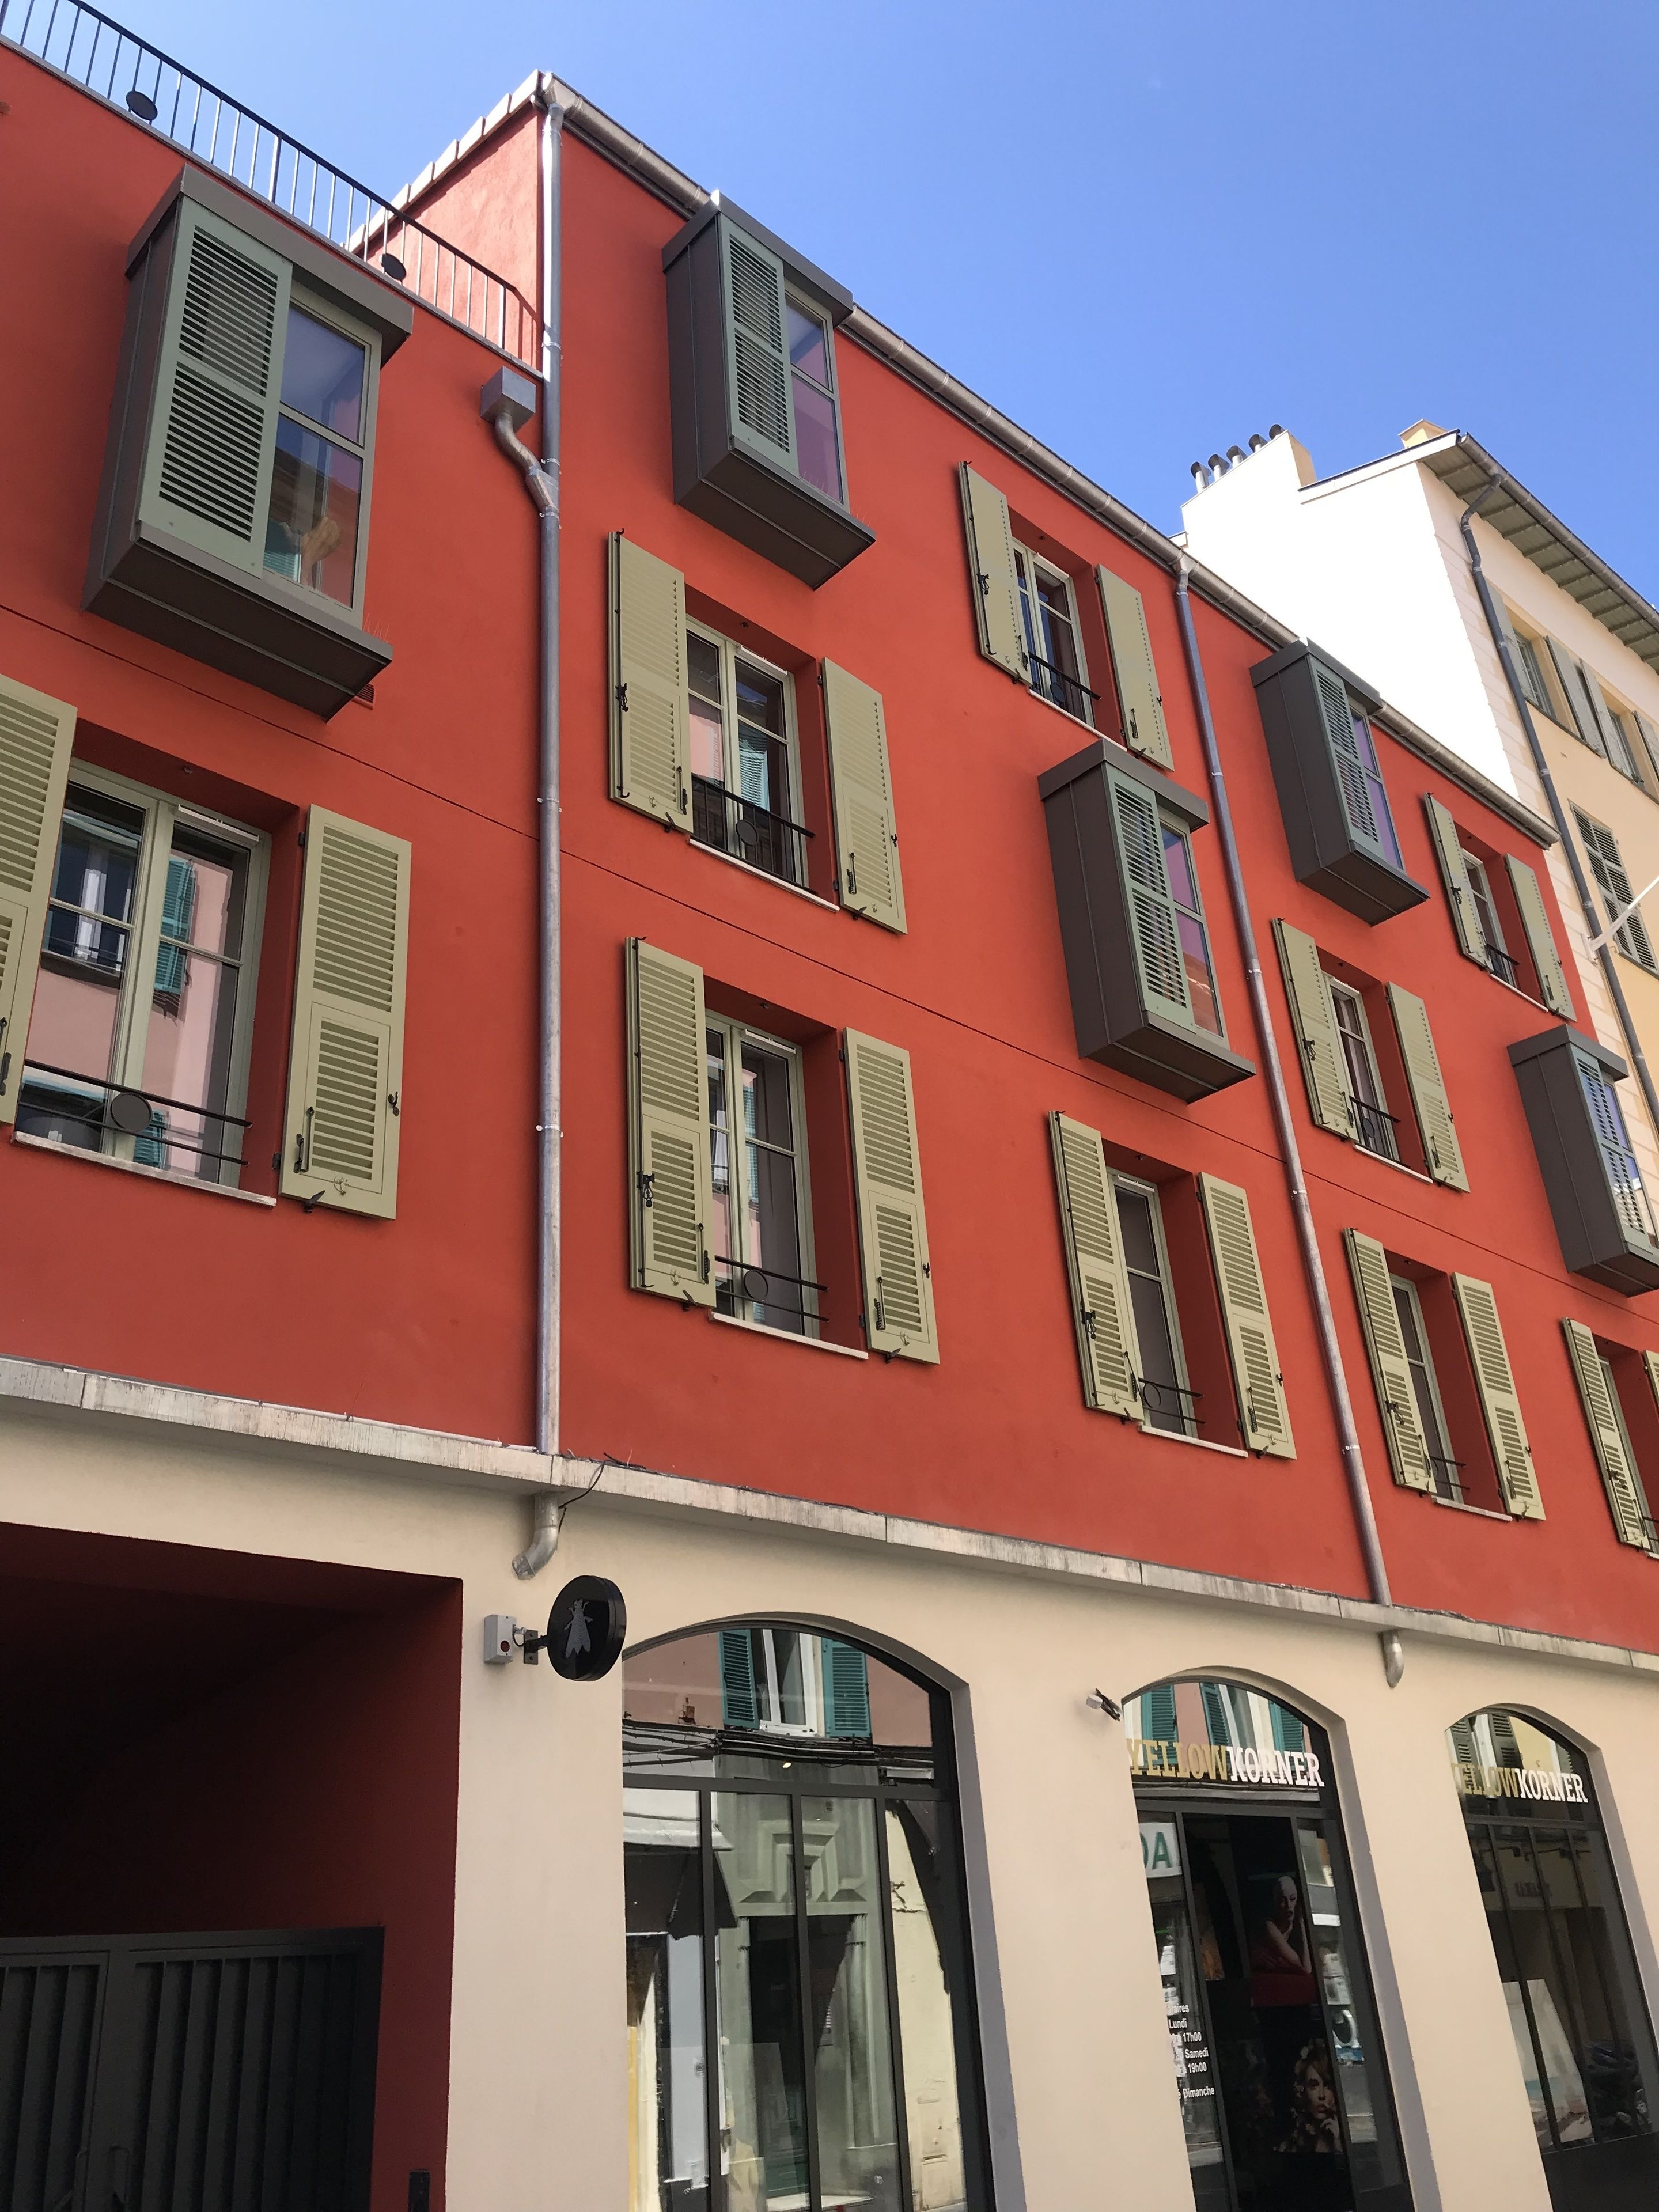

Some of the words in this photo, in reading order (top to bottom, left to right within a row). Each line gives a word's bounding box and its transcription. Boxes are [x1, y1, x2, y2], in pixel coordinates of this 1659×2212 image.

[1168, 2018, 1187, 2029] Lundi
[1183, 2031, 1202, 2042] 17h00
[1184, 2047, 1209, 2059] Samedi
[1188, 2062, 1207, 2073] 19h00
[1182, 2085, 1215, 2099] Dimanche
